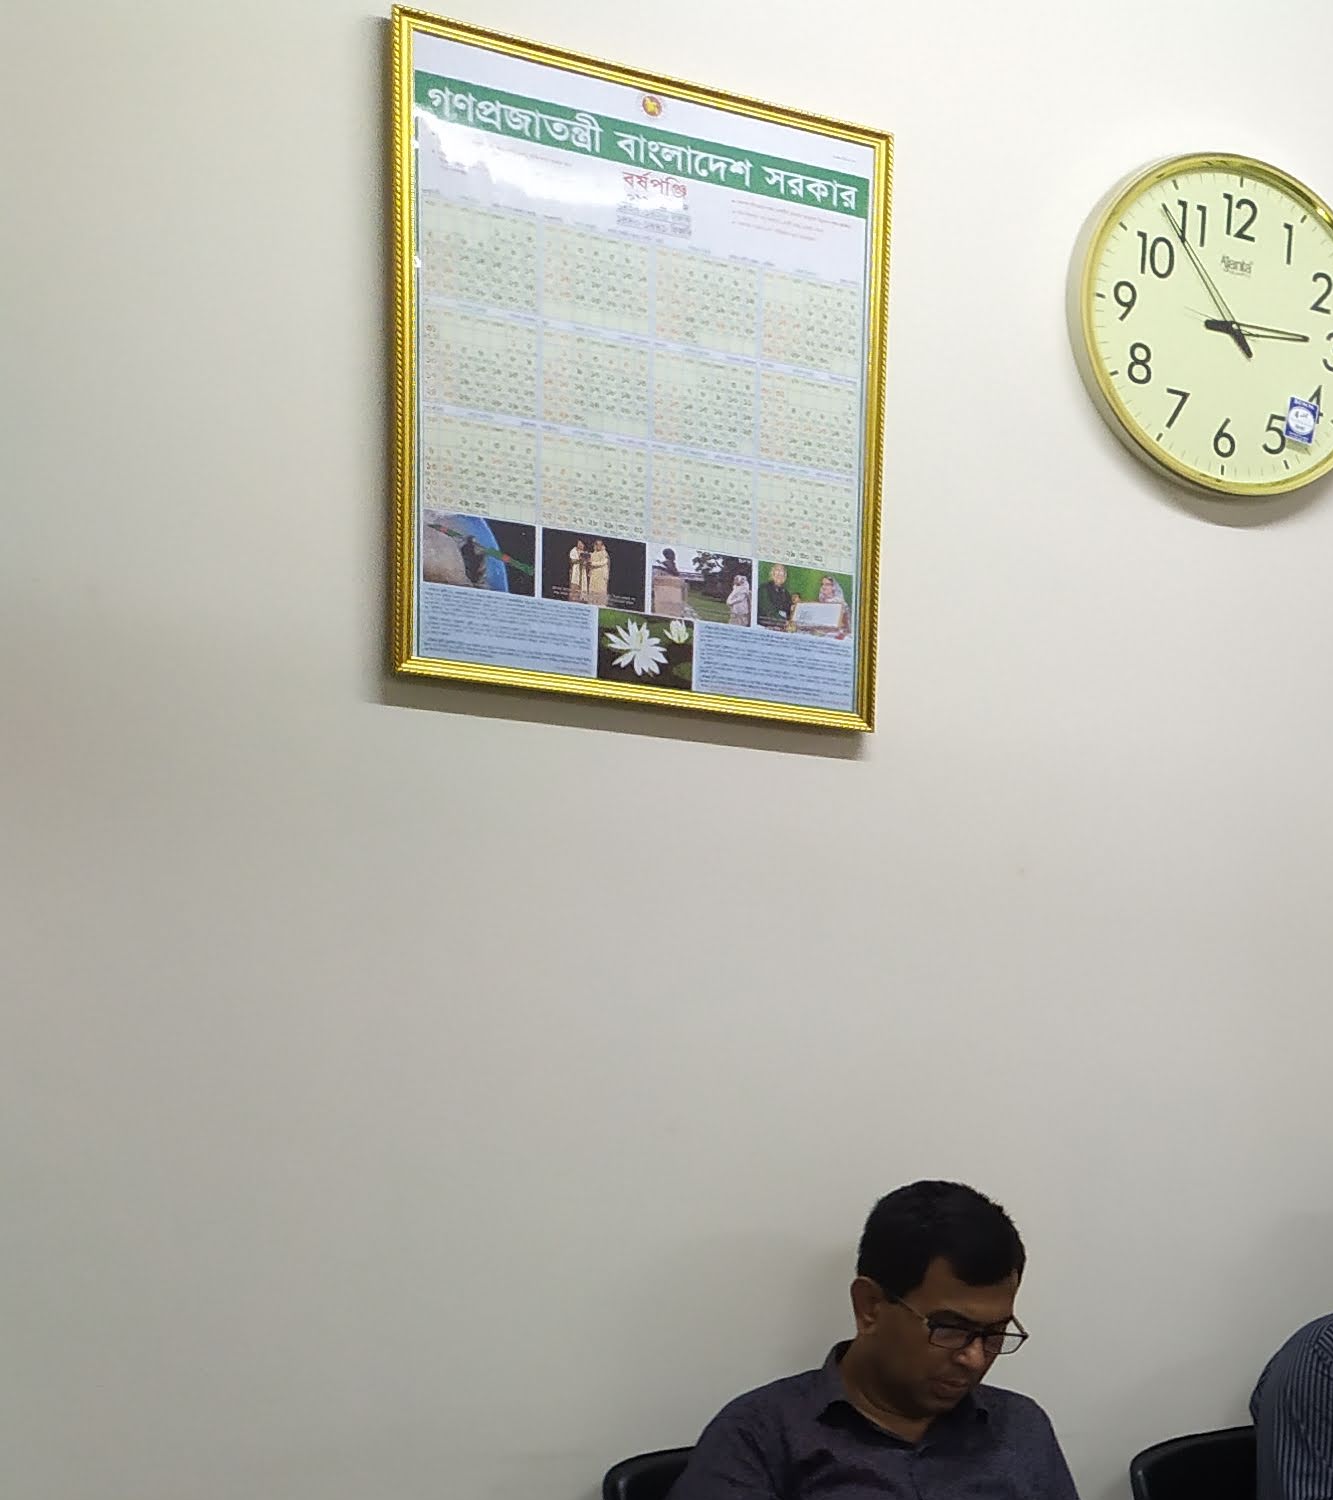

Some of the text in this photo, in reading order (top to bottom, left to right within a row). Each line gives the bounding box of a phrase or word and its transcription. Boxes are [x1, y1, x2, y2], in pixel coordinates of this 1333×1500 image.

[428, 85, 858, 210] গণপ্রজাতন্ত্রী বাংলাদেশ সরকার
[1178, 200, 1207, 248] 11
[1222, 193, 1258, 242] 12
[1137, 230, 1175, 279] 10
[1283, 223, 1294, 264] 1
[1113, 281, 1137, 321] 9
[1311, 272, 1333, 315] 2
[1127, 342, 1152, 384] 8
[1166, 388, 1190, 429] 7
[1307, 385, 1324, 425] 4
[1213, 418, 1236, 458] 6
[1262, 414, 1286, 455] 5
